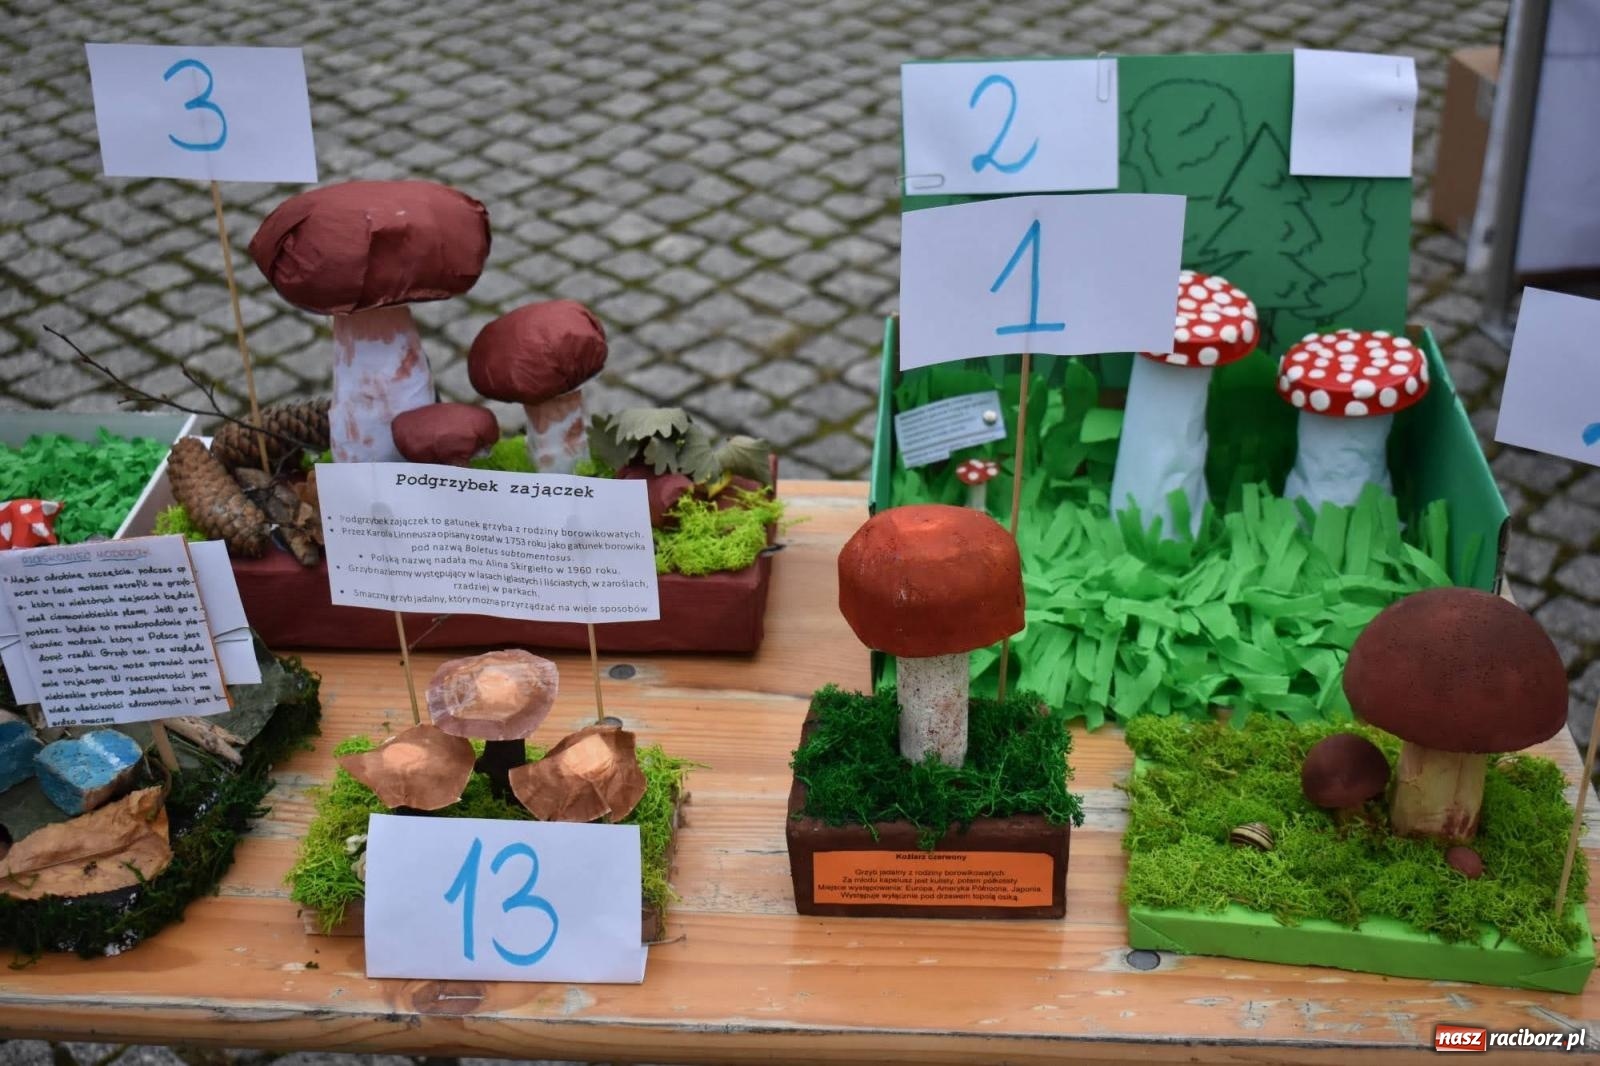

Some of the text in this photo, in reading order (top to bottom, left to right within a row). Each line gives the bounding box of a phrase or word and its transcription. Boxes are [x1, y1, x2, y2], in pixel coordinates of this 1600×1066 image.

[163, 59, 227, 152] 3
[969, 74, 1039, 174] 2
[990, 218, 1066, 336] 1
[396, 474, 594, 498] Podgrzybek zajączek
[340, 514, 388, 526] Podgrzybek
[390, 516, 429, 526] zajączek
[432, 516, 442, 525] to
[444, 517, 480, 528] gatunek
[482, 522, 512, 532] grzyba
[523, 527, 558, 537] rodziny
[342, 527, 366, 536] Przez
[366, 529, 393, 538] Karola
[394, 530, 437, 540] Linneusza
[438, 532, 470, 541] opisany
[471, 533, 494, 543] został
[506, 537, 526, 546] 1753
[527, 539, 546, 548] roku
[548, 541, 566, 551] jako
[568, 542, 602, 551] gatunek
[605, 542, 646, 551] borowika
[412, 544, 430, 552] pod
[433, 545, 462, 553] nazwą
[465, 545, 498, 556] Boletus
[348, 564, 374, 575] Grzyb
[374, 566, 413, 578] naziemny
[414, 569, 467, 580] występujący
[477, 570, 502, 581] lasach
[504, 572, 538, 584] iglastych
[371, 554, 400, 564] Polską
[402, 557, 432, 566] nazwę
[434, 556, 466, 564] nadała
[469, 558, 482, 566] mu
[486, 559, 508, 569] Alina
[510, 562, 553, 574] Skirgiełło
[568, 566, 592, 574] 1960
[454, 582, 490, 592] rzadziej
[354, 588, 388, 601] Smaczny
[390, 594, 413, 602] grzyb
[448, 595, 471, 604] który
[500, 600, 556, 612] przyrządzać
[572, 604, 598, 613] wiele
[600, 604, 648, 614] sposobów
[443, 837, 559, 966] 13
